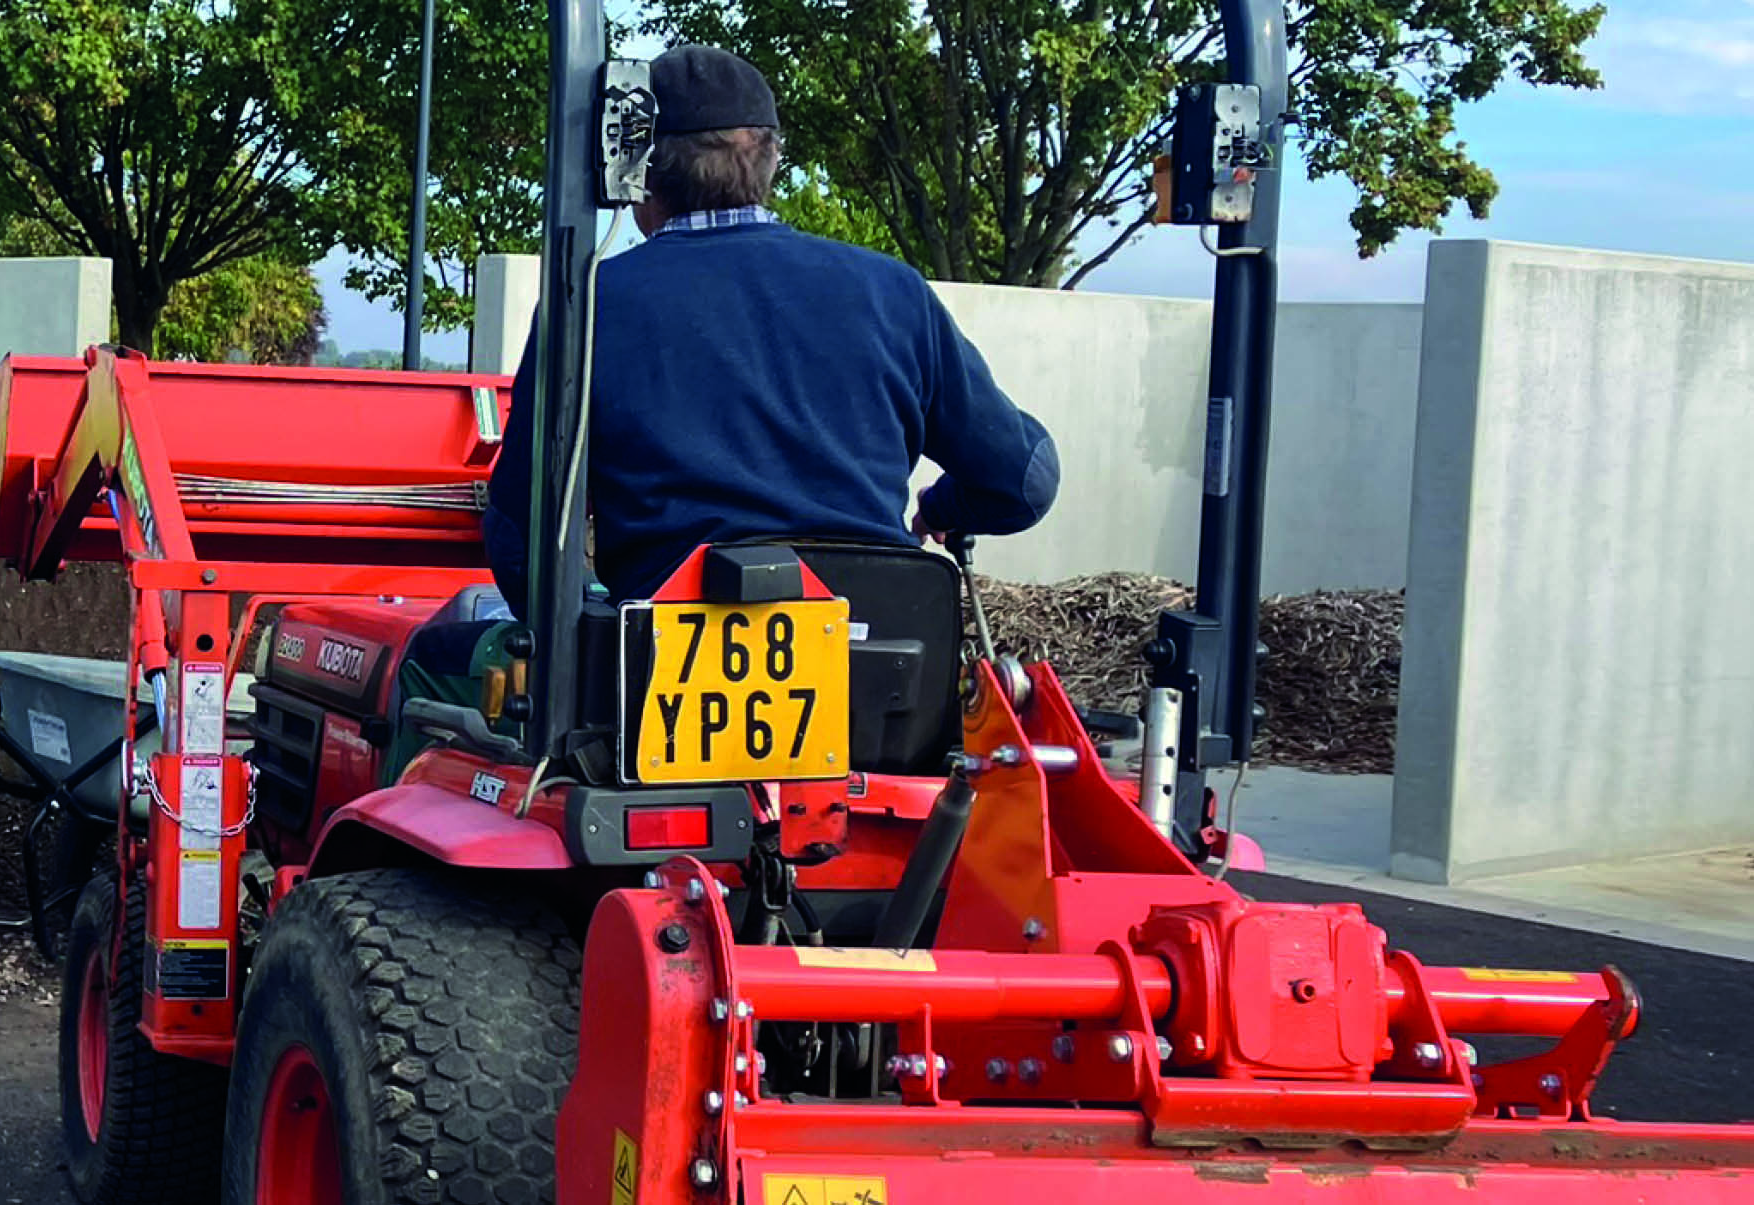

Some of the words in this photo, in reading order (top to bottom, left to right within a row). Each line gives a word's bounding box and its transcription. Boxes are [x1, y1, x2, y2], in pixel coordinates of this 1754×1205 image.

[316, 638, 365, 680] KUBOTA
[677, 611, 794, 684] 768
[656, 688, 816, 763] YP67
[470, 771, 506, 804] HST
